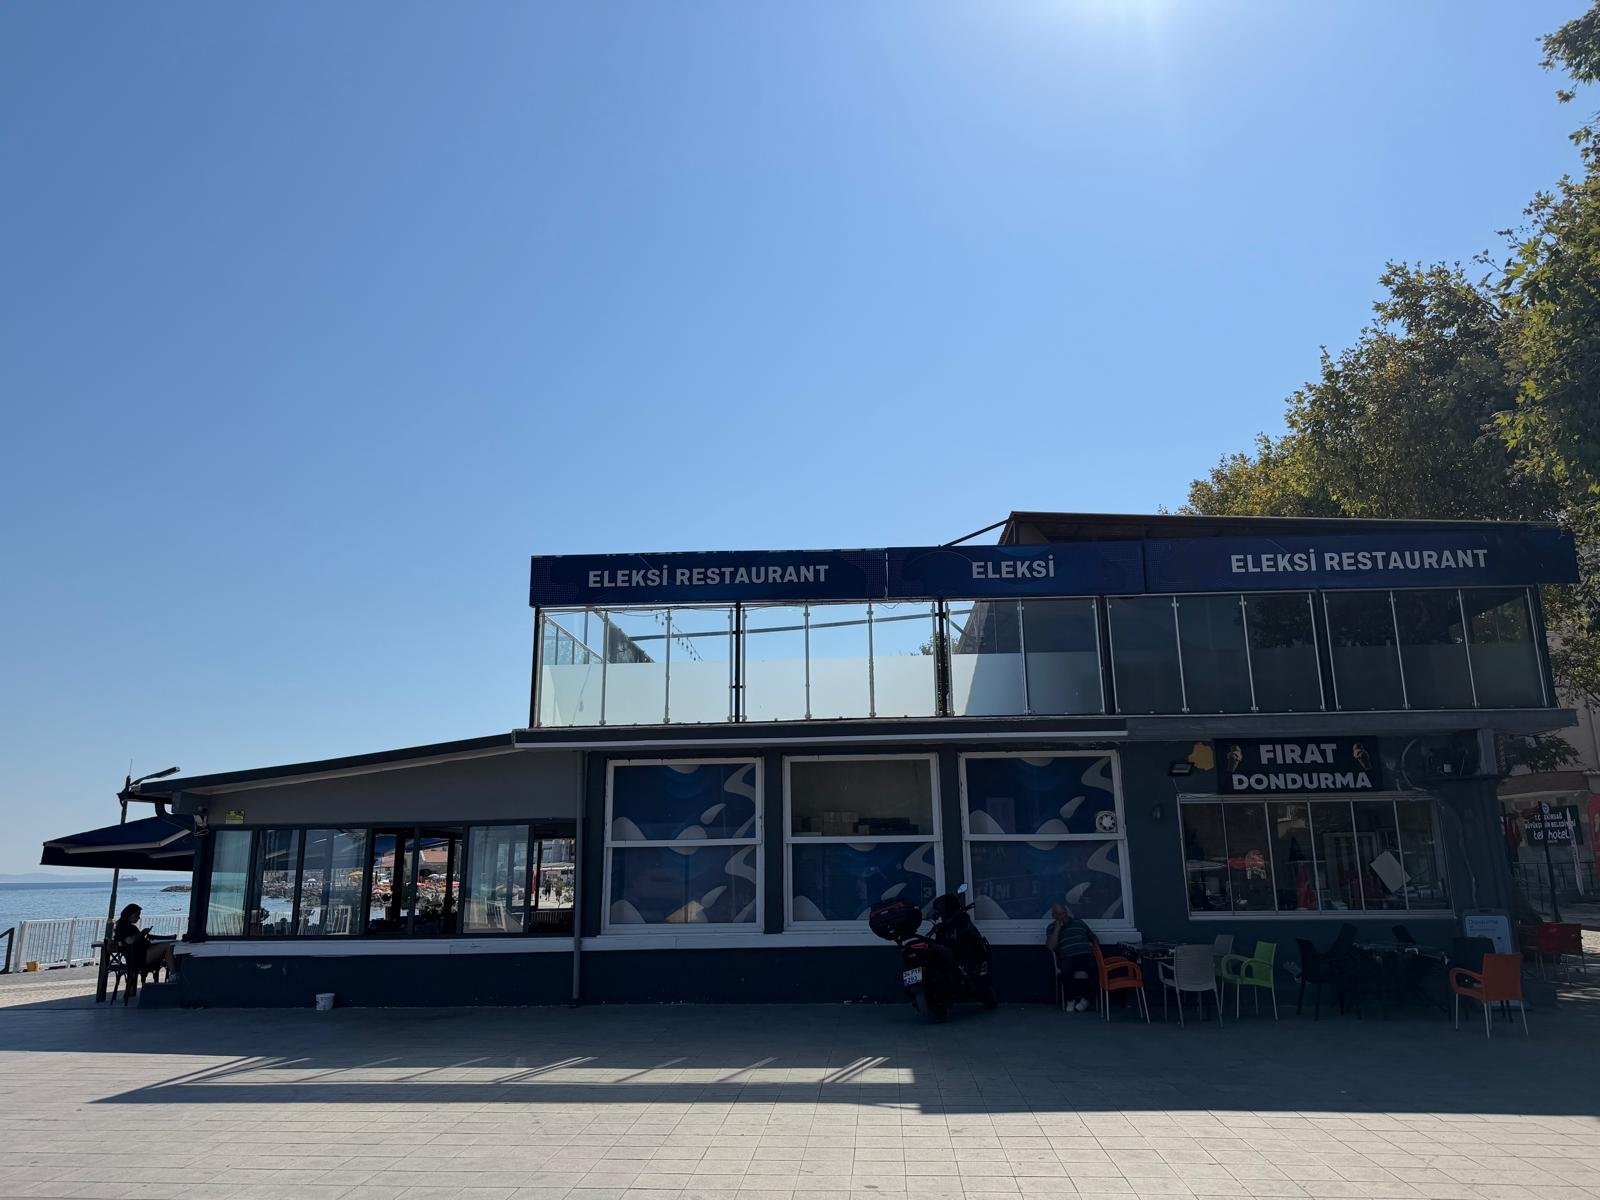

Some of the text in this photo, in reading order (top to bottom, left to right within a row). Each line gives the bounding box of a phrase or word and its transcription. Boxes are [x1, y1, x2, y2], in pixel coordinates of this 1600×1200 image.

[972, 554, 1055, 579] ELEKSİ
[1231, 549, 1488, 573] ELEKSİ RESTAURANT
[588, 564, 829, 588] ELEKSİ RESTAURANT
[1259, 743, 1337, 765] FIRAT
[1231, 772, 1373, 790] DONDURMA
[1548, 829, 1569, 839] hotel
